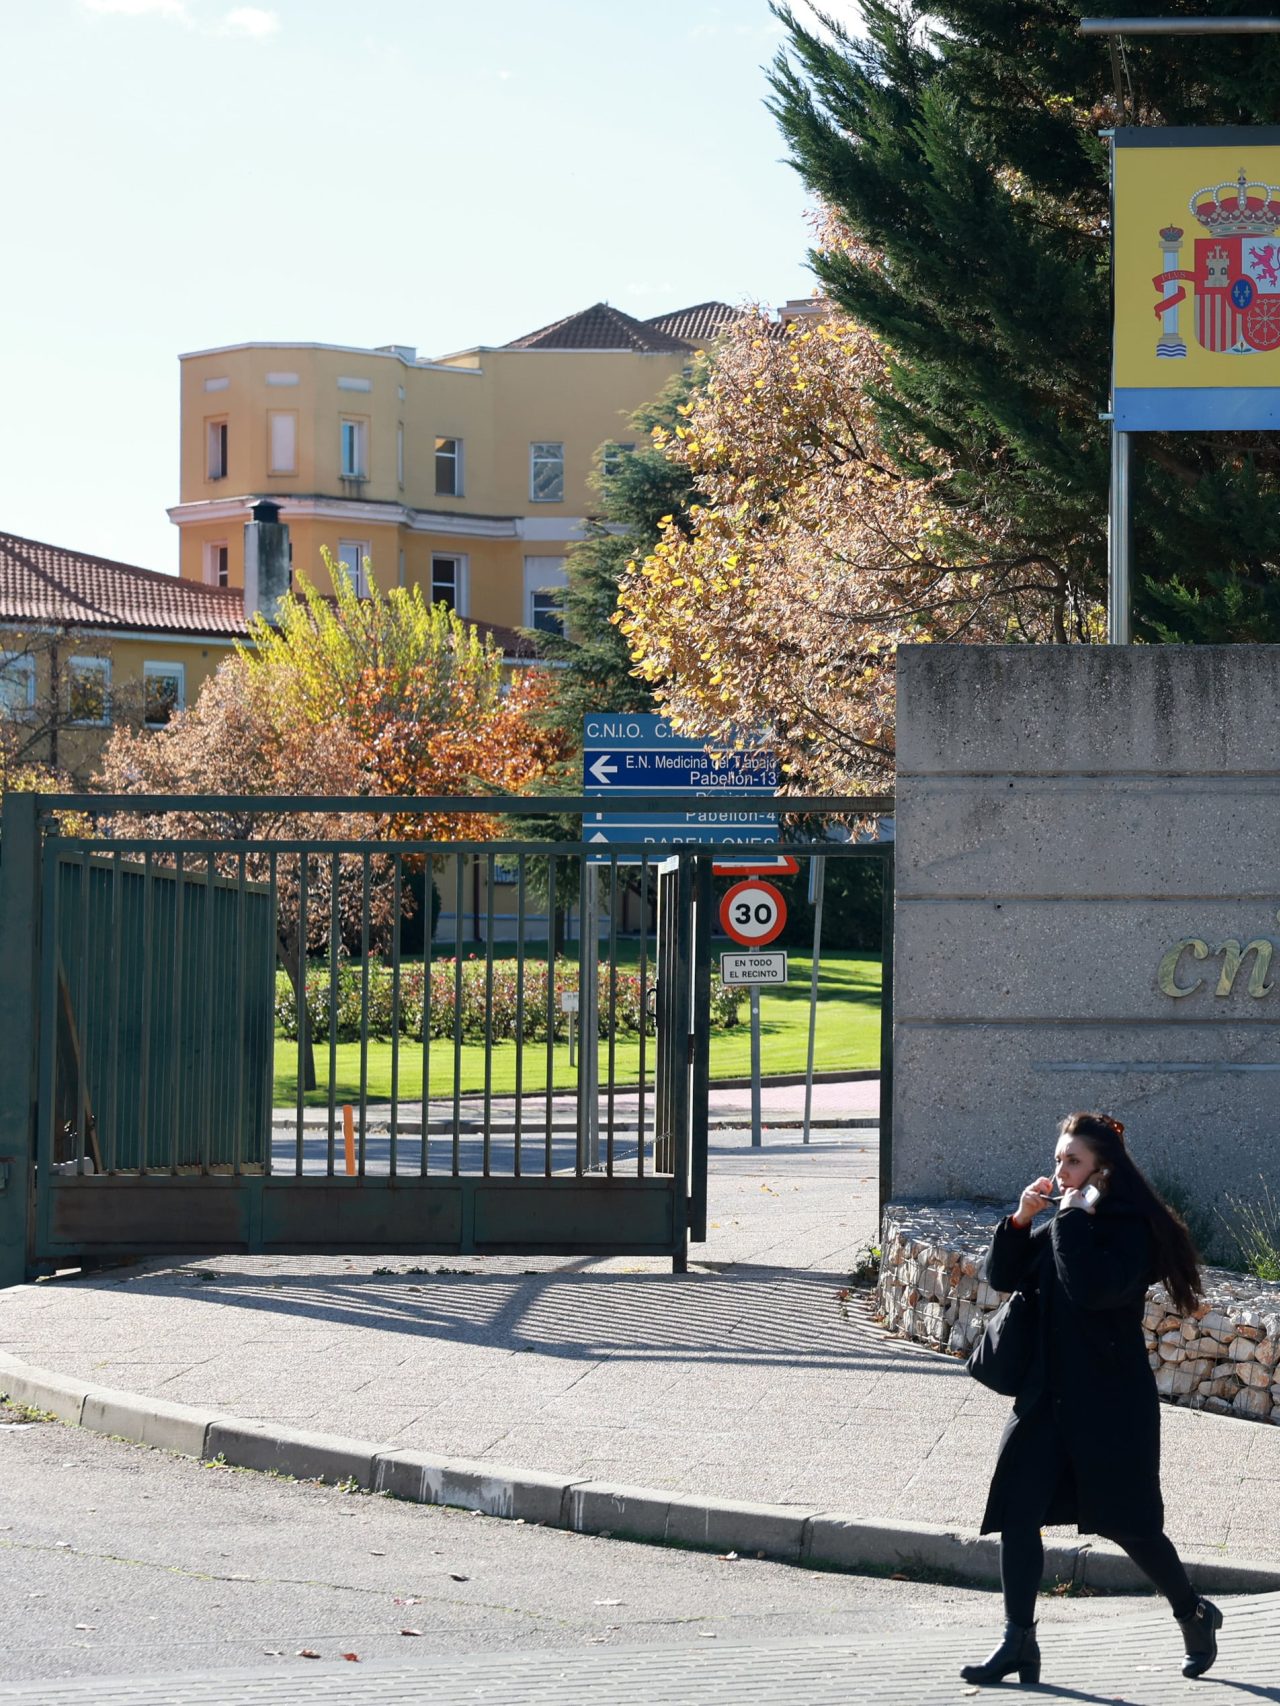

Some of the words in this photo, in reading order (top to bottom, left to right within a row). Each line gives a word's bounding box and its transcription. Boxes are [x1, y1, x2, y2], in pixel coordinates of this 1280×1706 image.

[587, 723, 644, 738] C.N.I.O.
[626, 756, 651, 769] E.N.
[655, 755, 708, 769] Medicina
[733, 755, 777, 772] Tabajo
[735, 903, 772, 925] 30
[735, 959, 746, 967] EN
[749, 959, 773, 967] TODO
[729, 971, 739, 979] EL
[742, 970, 778, 978] RECINTO
